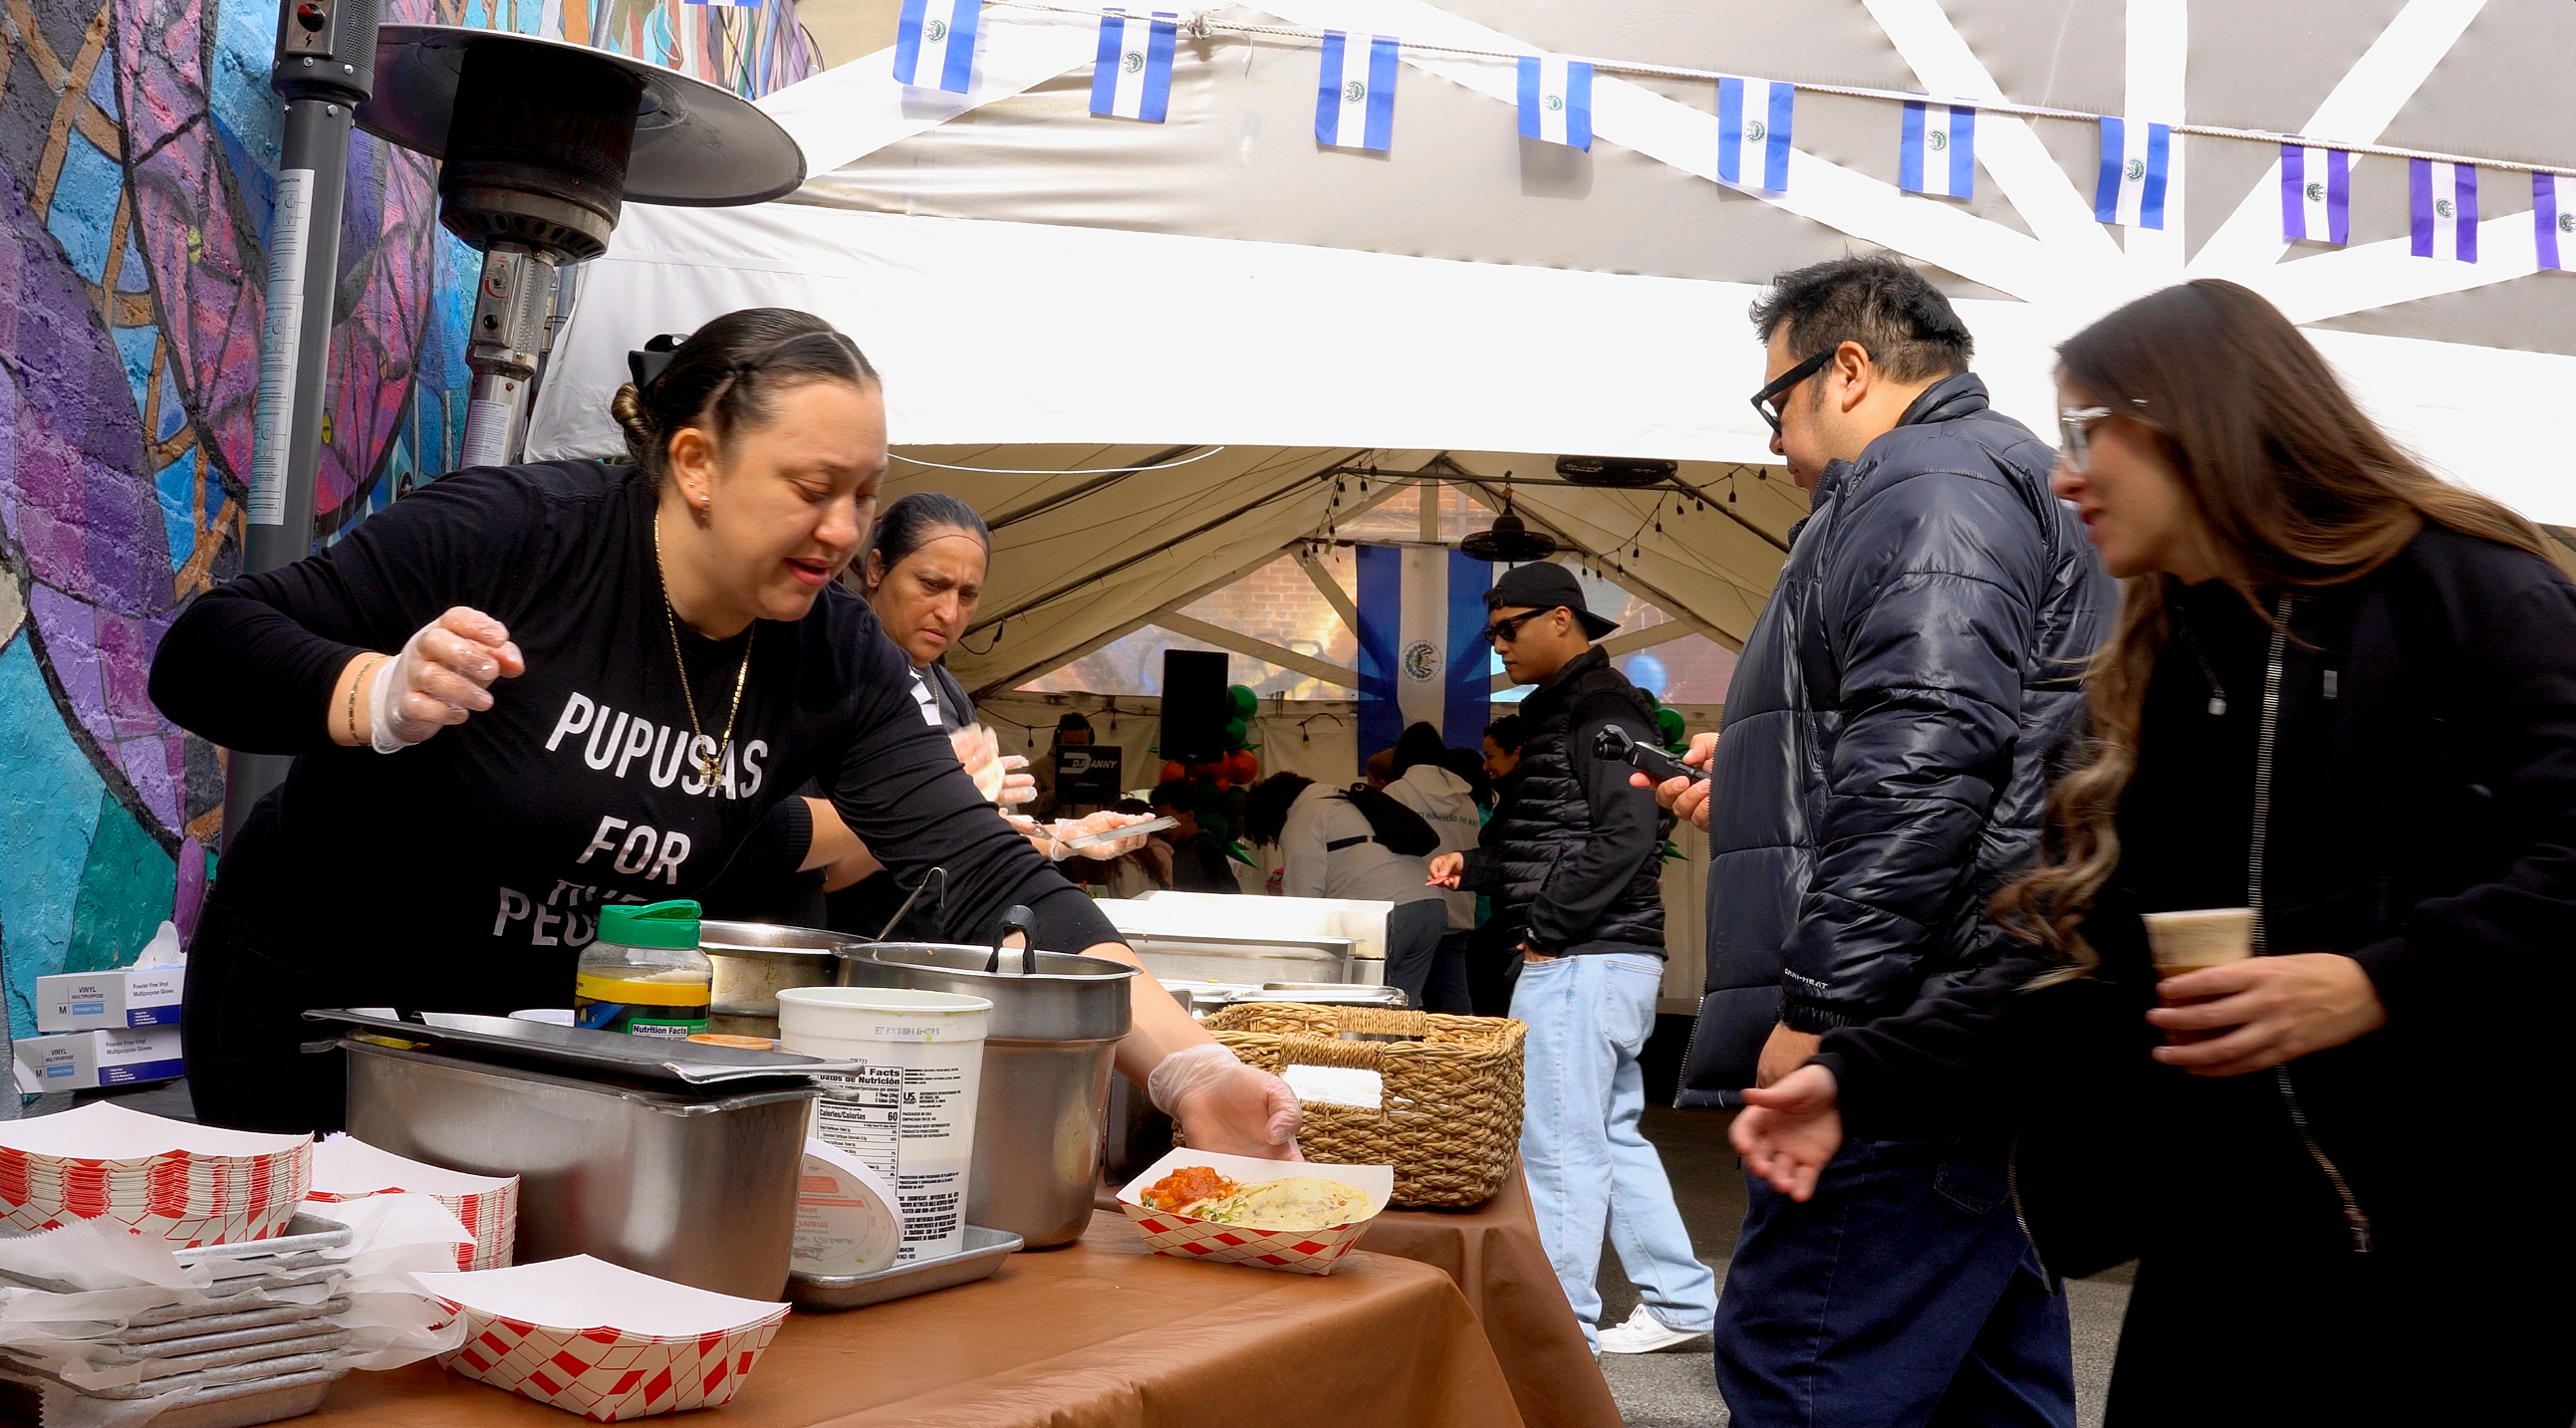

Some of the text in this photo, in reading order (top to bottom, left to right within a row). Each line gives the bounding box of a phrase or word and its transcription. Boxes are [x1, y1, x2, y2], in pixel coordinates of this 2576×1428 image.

[545, 691, 768, 800] PUPUSAS
[576, 815, 691, 885] FOR
[1784, 967, 1829, 990] OMNI-HEAT
[59, 1006, 68, 1015] M
[633, 1025, 667, 1035] Nutrition
[668, 1026, 687, 1035] Facts
[36, 1070, 43, 1078] M
[869, 1068, 901, 1076] Facts
[859, 1076, 901, 1085] Nutrición
[888, 1111, 899, 1121] 60
